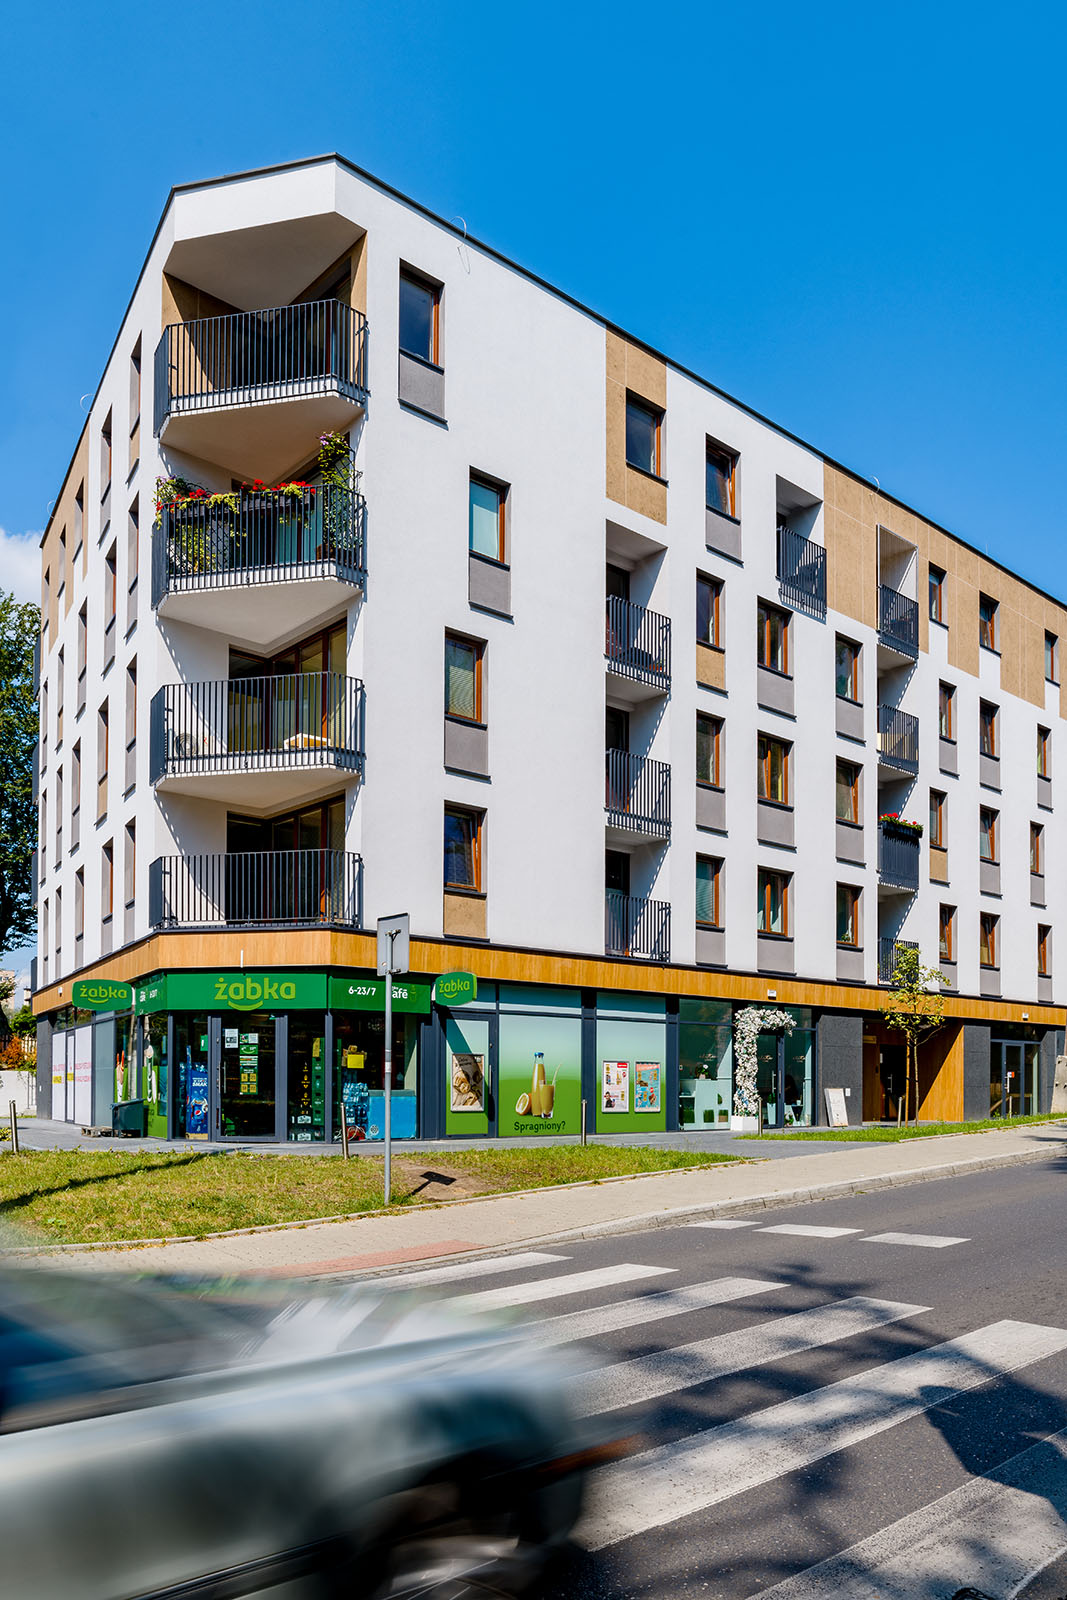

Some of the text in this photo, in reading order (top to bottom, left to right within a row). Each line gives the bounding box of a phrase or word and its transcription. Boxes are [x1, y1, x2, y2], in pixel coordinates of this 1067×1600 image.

[80, 985, 127, 999] żabka
[214, 977, 296, 1000] żabka
[348, 986, 376, 996] 6-23/7
[439, 979, 470, 993] żabka
[514, 1121, 566, 1133] Spragniony?
